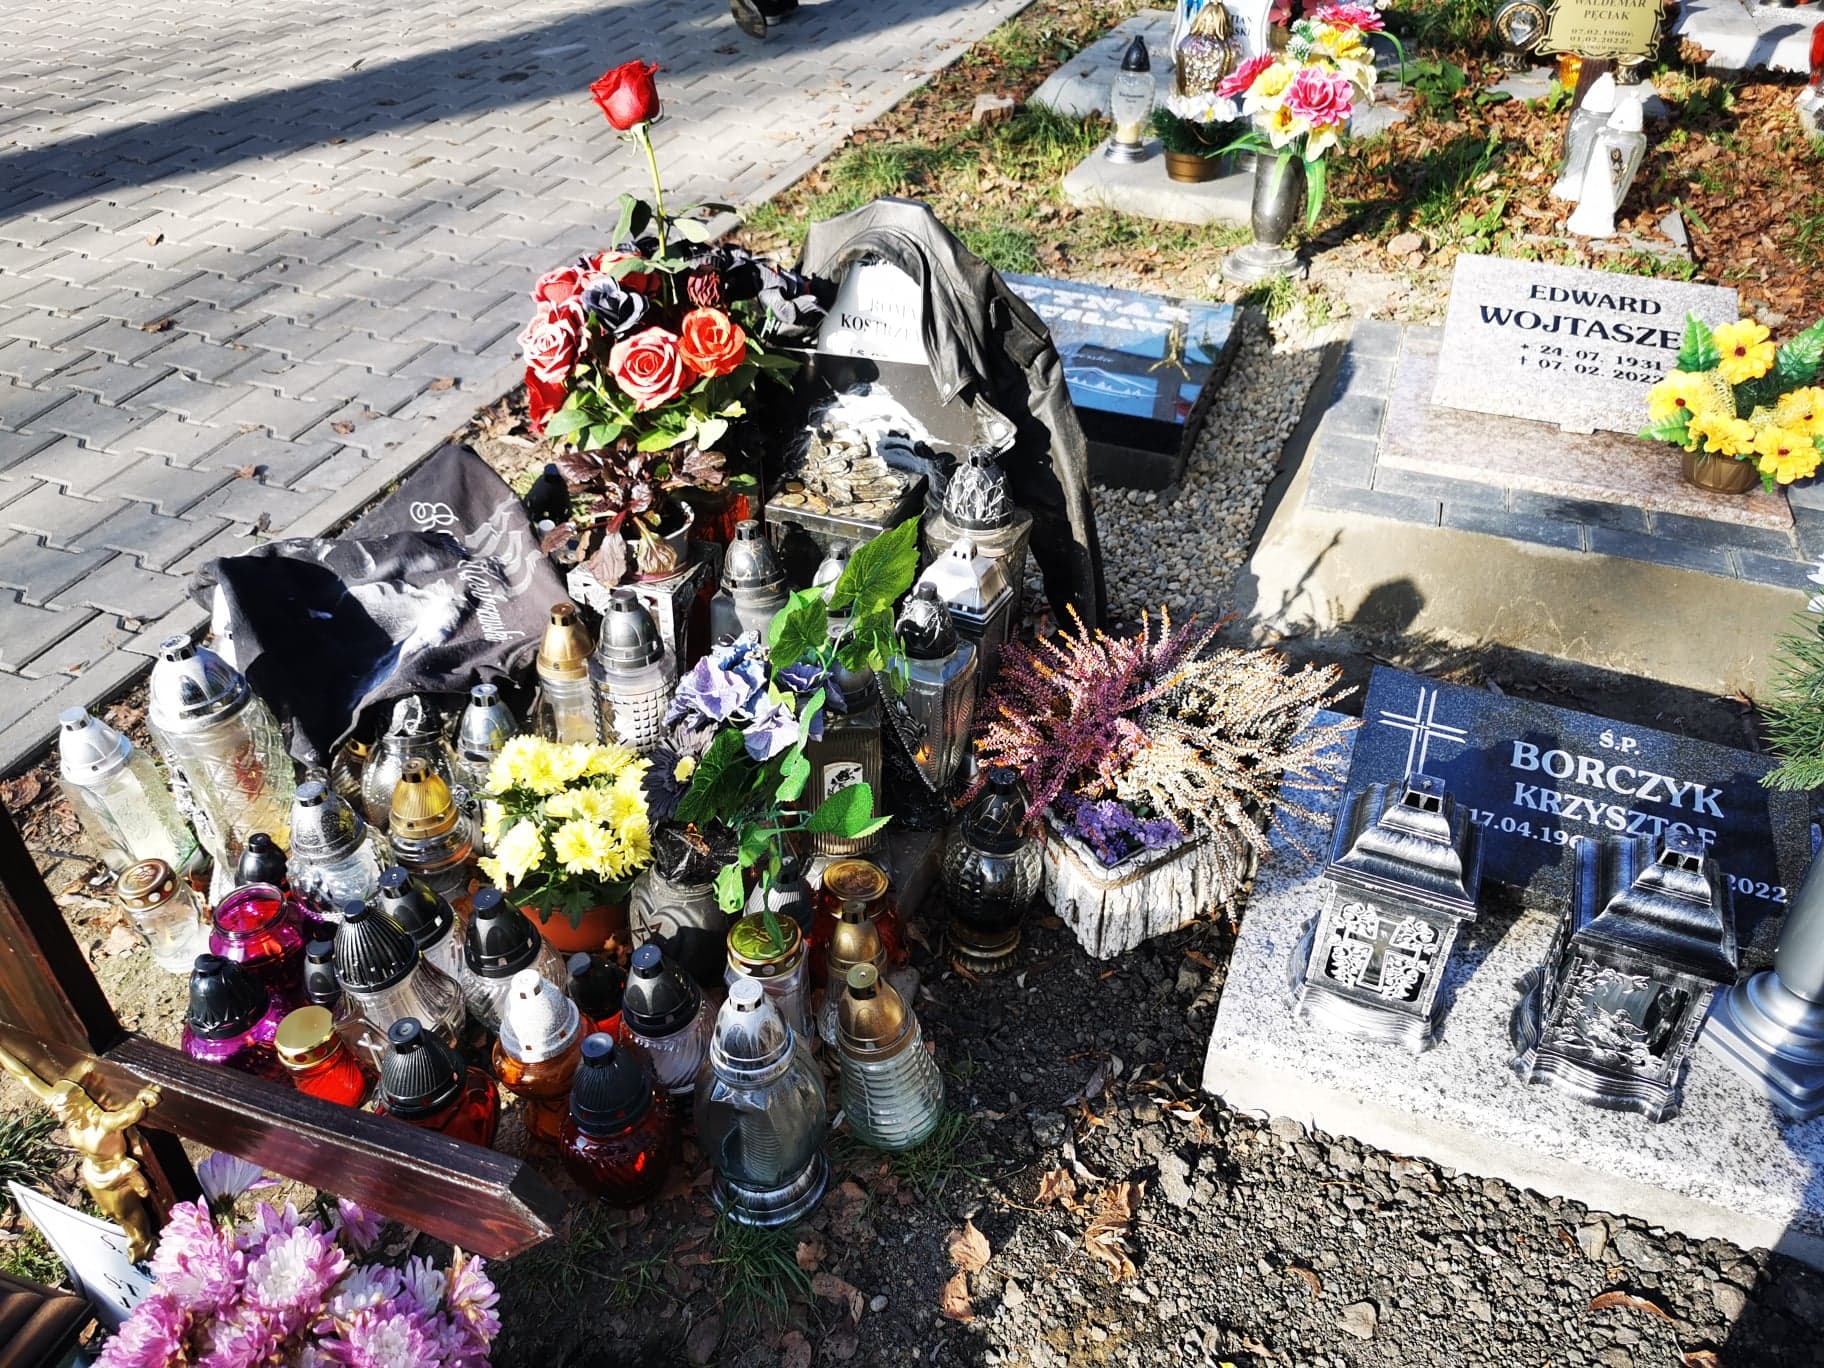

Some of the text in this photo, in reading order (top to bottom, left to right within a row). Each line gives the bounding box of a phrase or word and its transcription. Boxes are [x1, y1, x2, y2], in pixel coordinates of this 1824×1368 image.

[1584, 10, 1630, 21] PĘCIAK
[1529, 284, 1661, 315] EDWARD
[1480, 305, 1681, 351] WOJTASZE
[1617, 356, 1662, 370] 1931
[1599, 729, 1640, 755] Ś.P.
[1510, 740, 1725, 818] BORCZYK
